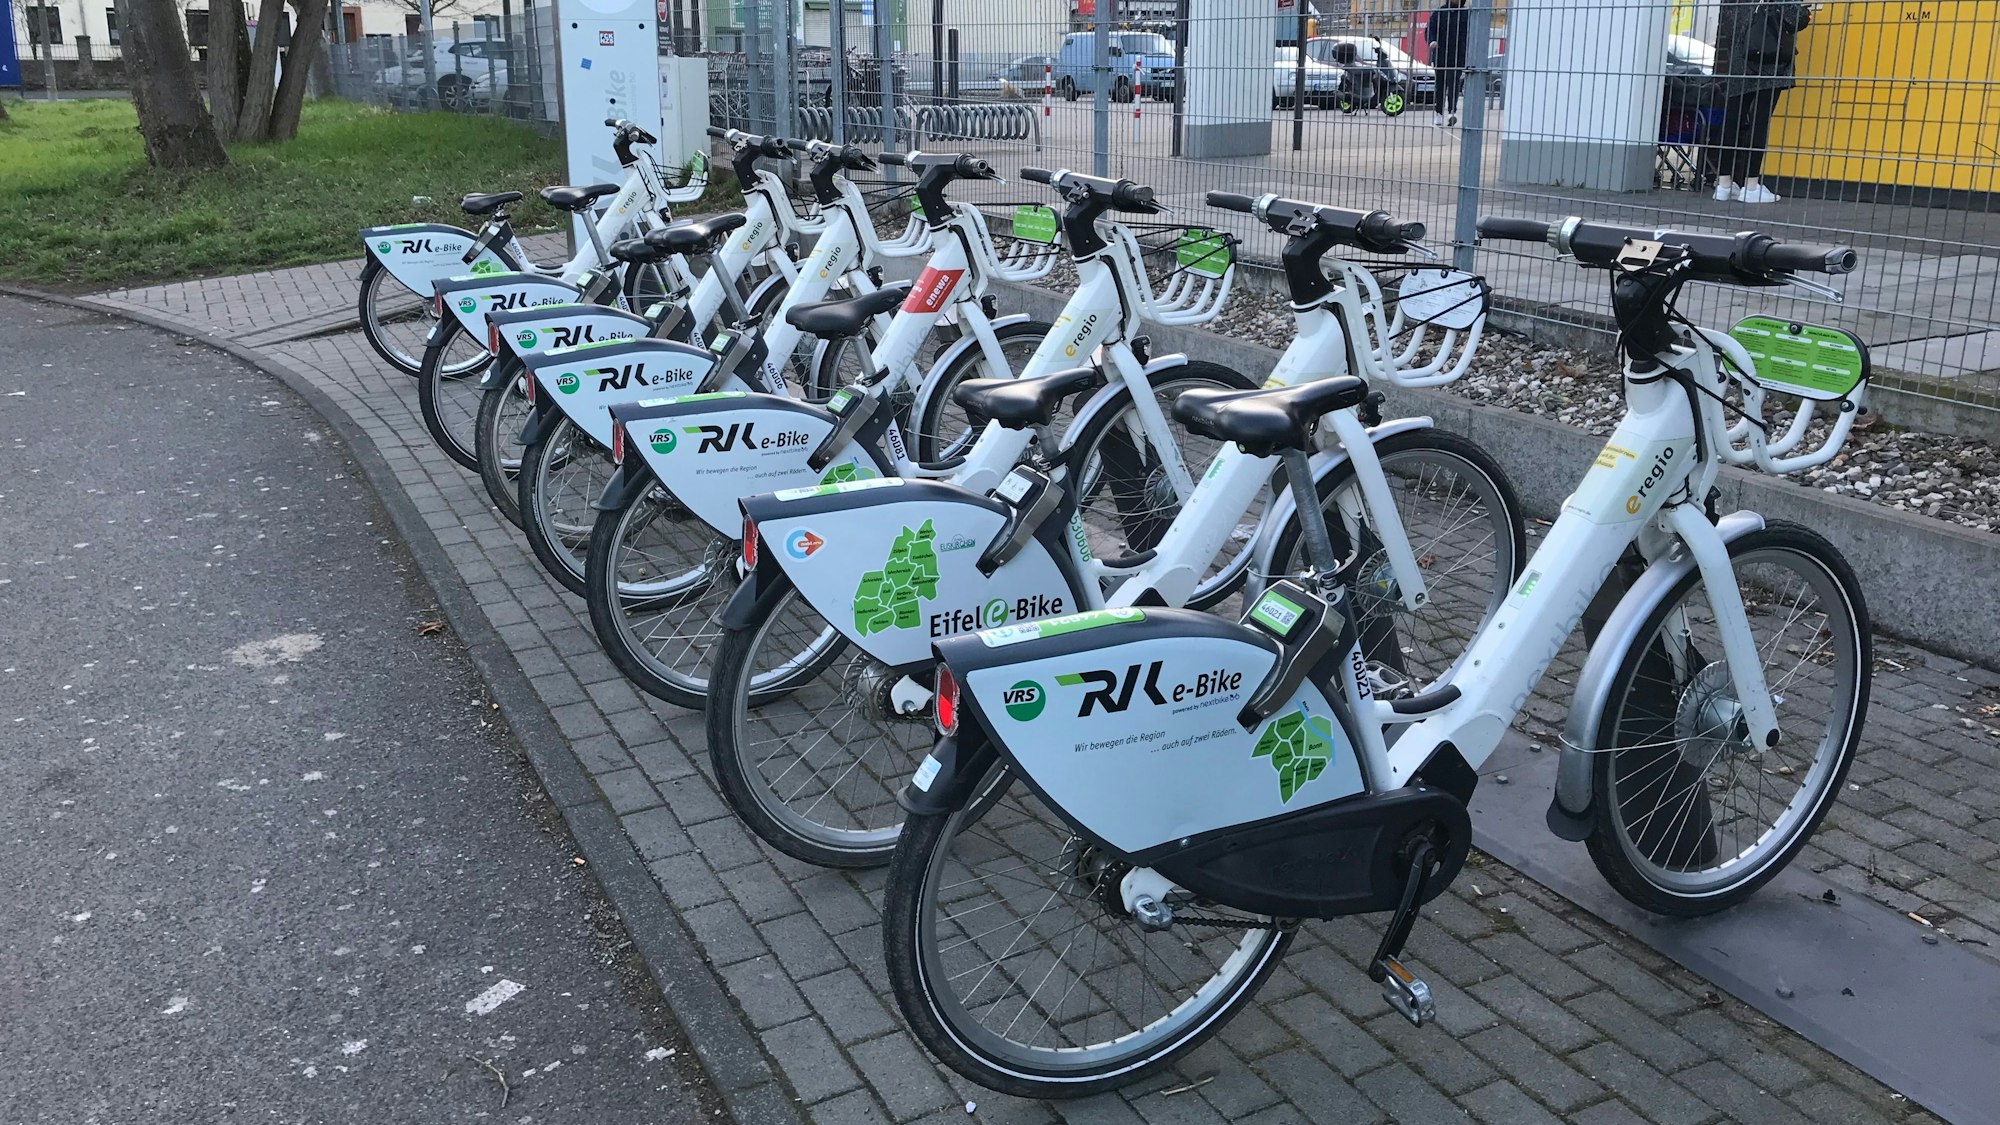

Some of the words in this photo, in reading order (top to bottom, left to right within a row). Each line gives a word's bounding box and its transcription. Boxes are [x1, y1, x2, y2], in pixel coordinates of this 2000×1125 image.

[1905, 11, 1917, 20] XL
[1921, 11, 1931, 20] M
[434, 243, 462, 252] e-Bike
[926, 274, 950, 306] enewa
[516, 333, 532, 341] VRS
[556, 376, 574, 386] VRS
[652, 368, 693, 385] e-Bike
[767, 362, 784, 390] 46006
[649, 434, 670, 443] VRS
[761, 430, 809, 449] e-Bike
[889, 429, 905, 461] 46081
[706, 467, 729, 475] bewegen
[739, 465, 757, 473] Region
[1070, 515, 1090, 562] 530606
[930, 605, 982, 638] Eifel
[1261, 603, 1282, 620] 46021
[1172, 668, 1242, 702] e-Bike
[1351, 651, 1371, 700] 46021
[1003, 687, 1036, 705] VRS
[1172, 705, 1193, 715] powered
[1200, 694, 1229, 708] nextbike
[1075, 742, 1088, 752] Wir
[1090, 739, 1124, 751] bewegen
[1126, 734, 1138, 745] die
[1140, 730, 1166, 743] Region
[1161, 739, 1179, 750] auch
[1181, 735, 1195, 747] auf
[1194, 732, 1211, 744] zwei
[1211, 728, 1237, 739] Rädern.
